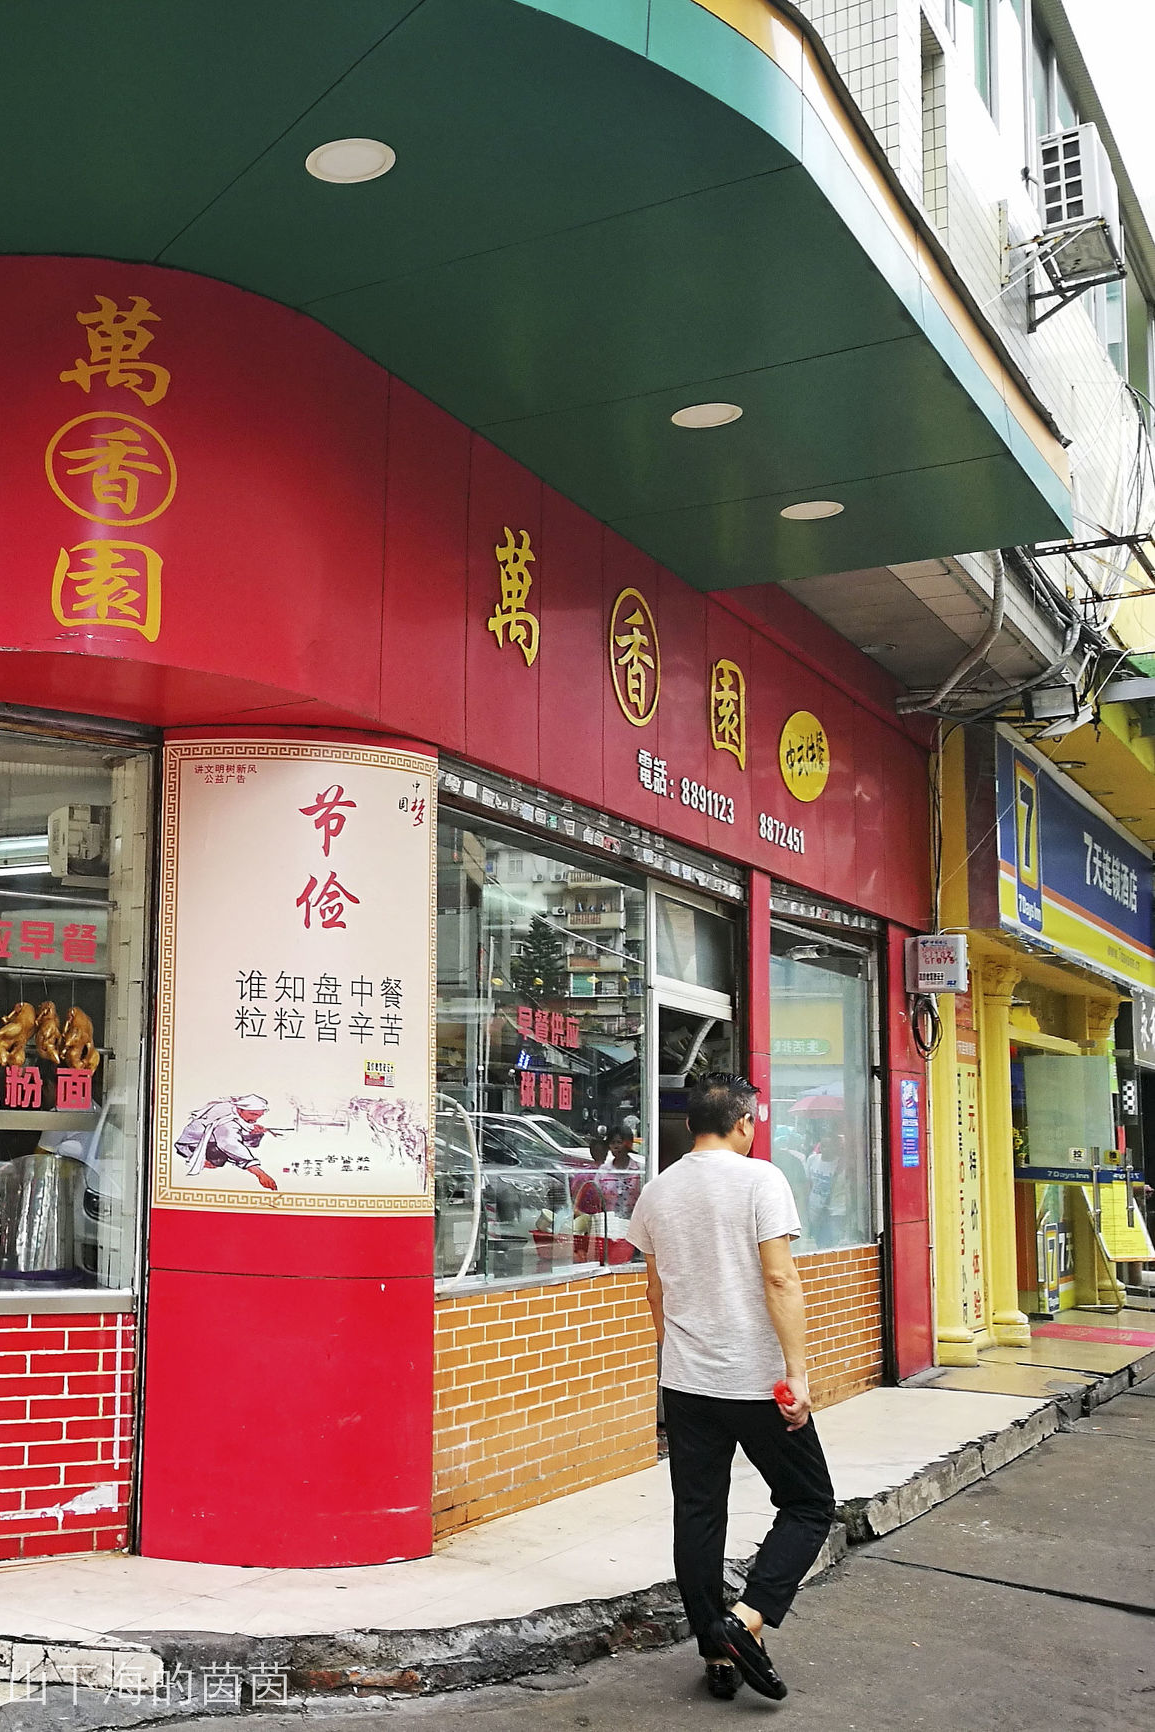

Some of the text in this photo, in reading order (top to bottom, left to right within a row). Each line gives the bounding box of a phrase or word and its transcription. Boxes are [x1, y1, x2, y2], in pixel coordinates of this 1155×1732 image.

[47, 295, 177, 642] 萬香園
[488, 526, 746, 771] 萬香園
[204, 774, 245, 784] 公益广告
[680, 776, 735, 825] 8891123
[759, 813, 806, 855] 8872451
[296, 785, 361, 930] 节俭
[235, 969, 404, 1009] 谁知盘中餐
[235, 1005, 404, 1047] 粒粒皆辛苦
[517, 1006, 580, 1049] 早餐供应
